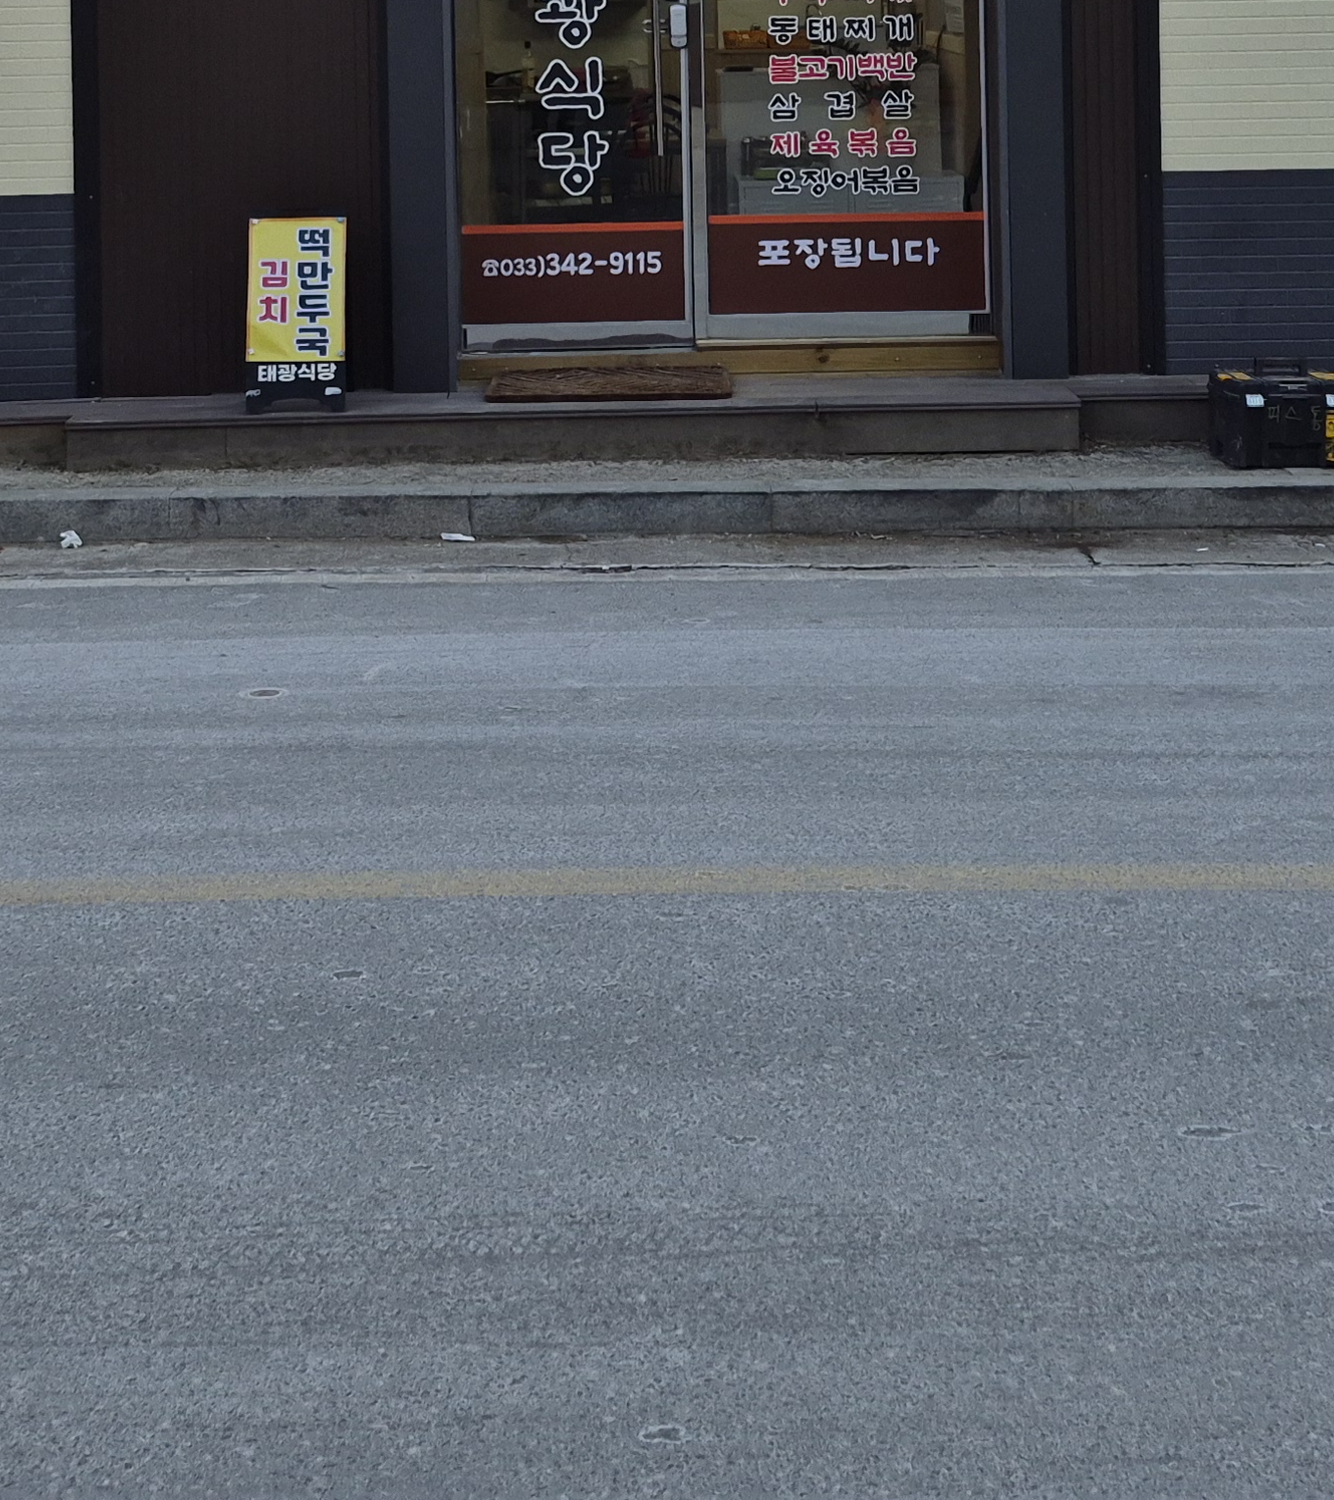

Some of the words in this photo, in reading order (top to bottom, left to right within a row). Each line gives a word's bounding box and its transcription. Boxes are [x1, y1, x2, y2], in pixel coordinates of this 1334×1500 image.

[768, 13, 916, 45] 동태찌개
[768, 52, 918, 85] 불고기백반
[767, 89, 915, 122] 삼겹살
[769, 126, 917, 158] 제육볶음
[771, 164, 920, 197] 오징어볶음
[757, 237, 941, 270] 포장됩니다
[257, 259, 290, 325] 김치
[257, 363, 337, 383] 태광식당
